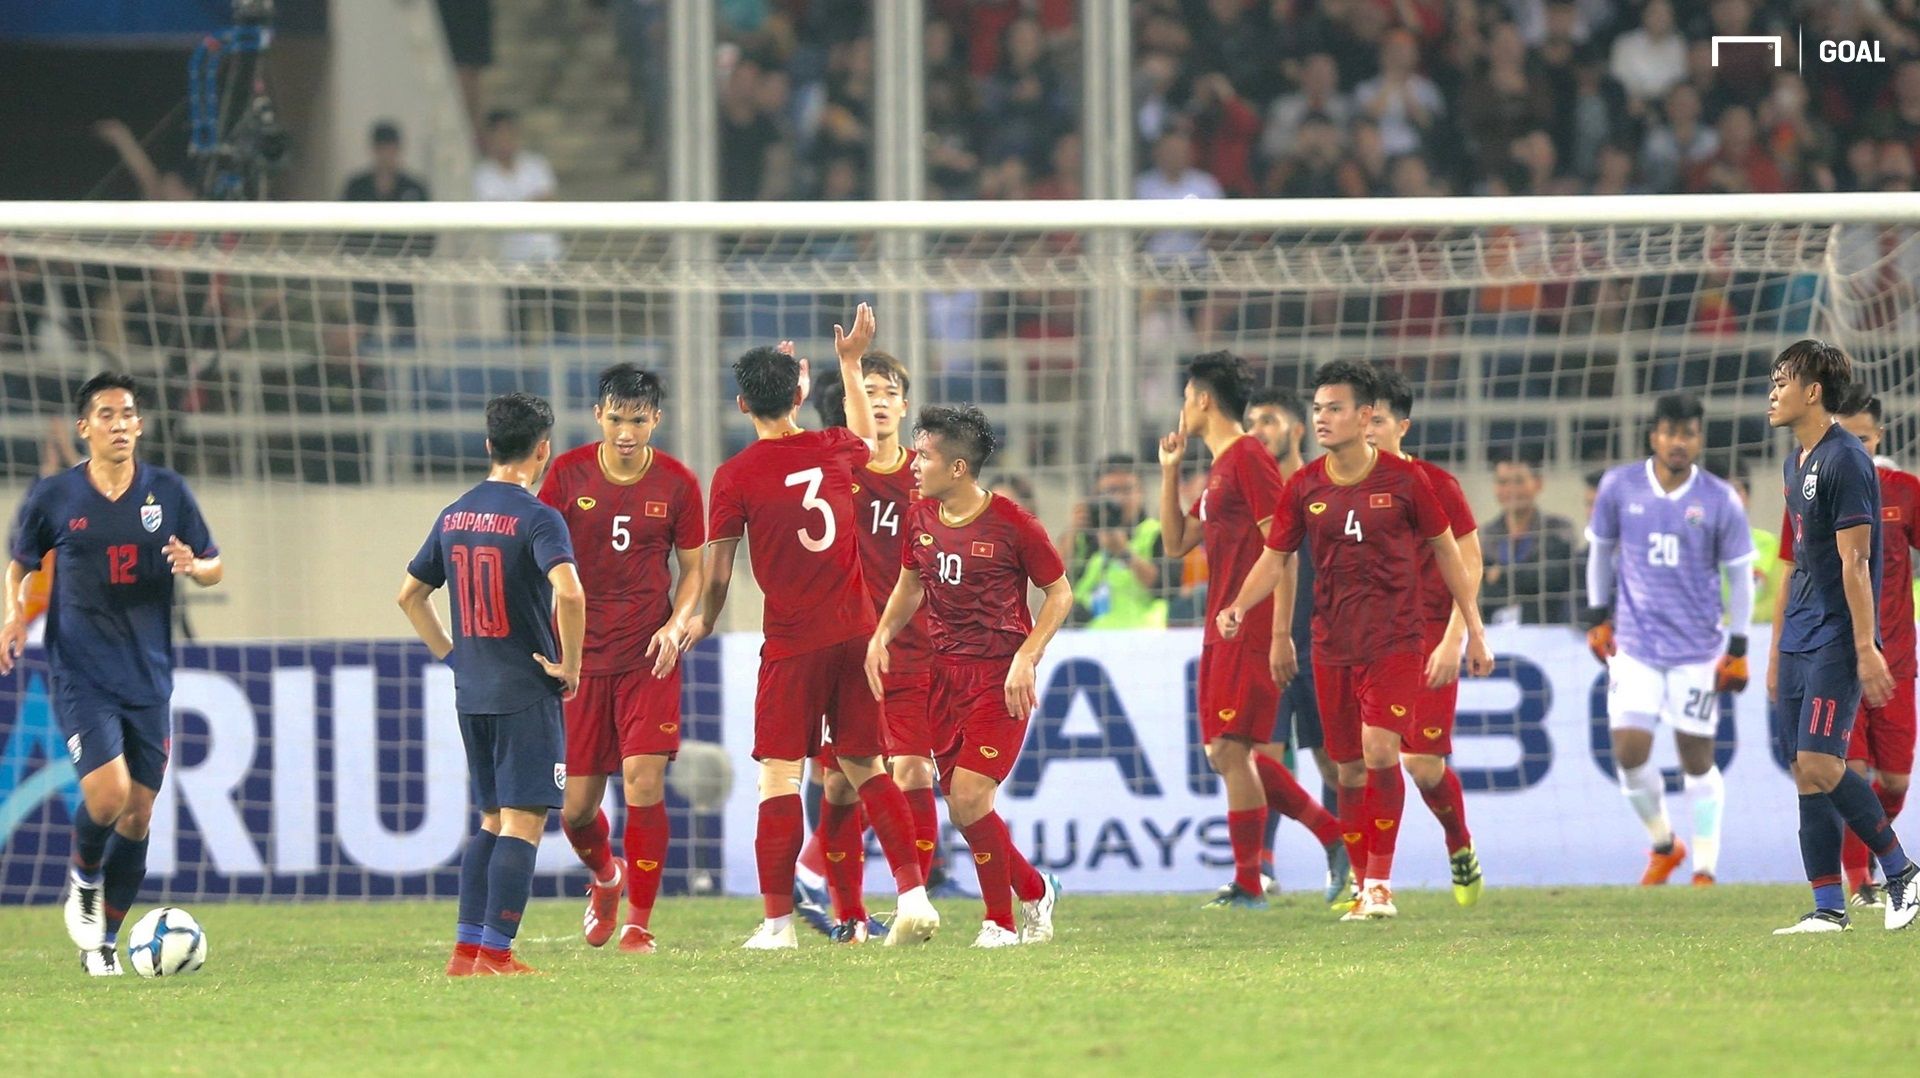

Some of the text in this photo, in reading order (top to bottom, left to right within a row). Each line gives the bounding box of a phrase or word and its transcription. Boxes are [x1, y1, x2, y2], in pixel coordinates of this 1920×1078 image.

[784, 467, 836, 552] 3
[869, 499, 899, 537] 14
[1344, 509, 1363, 542] 4
[611, 515, 632, 552] 5
[1647, 531, 1680, 567] 20
[106, 544, 139, 585] 12
[936, 551, 972, 585] 10
[451, 544, 511, 638] 10
[1683, 688, 1718, 721] 20
[1809, 697, 1837, 737] 11
